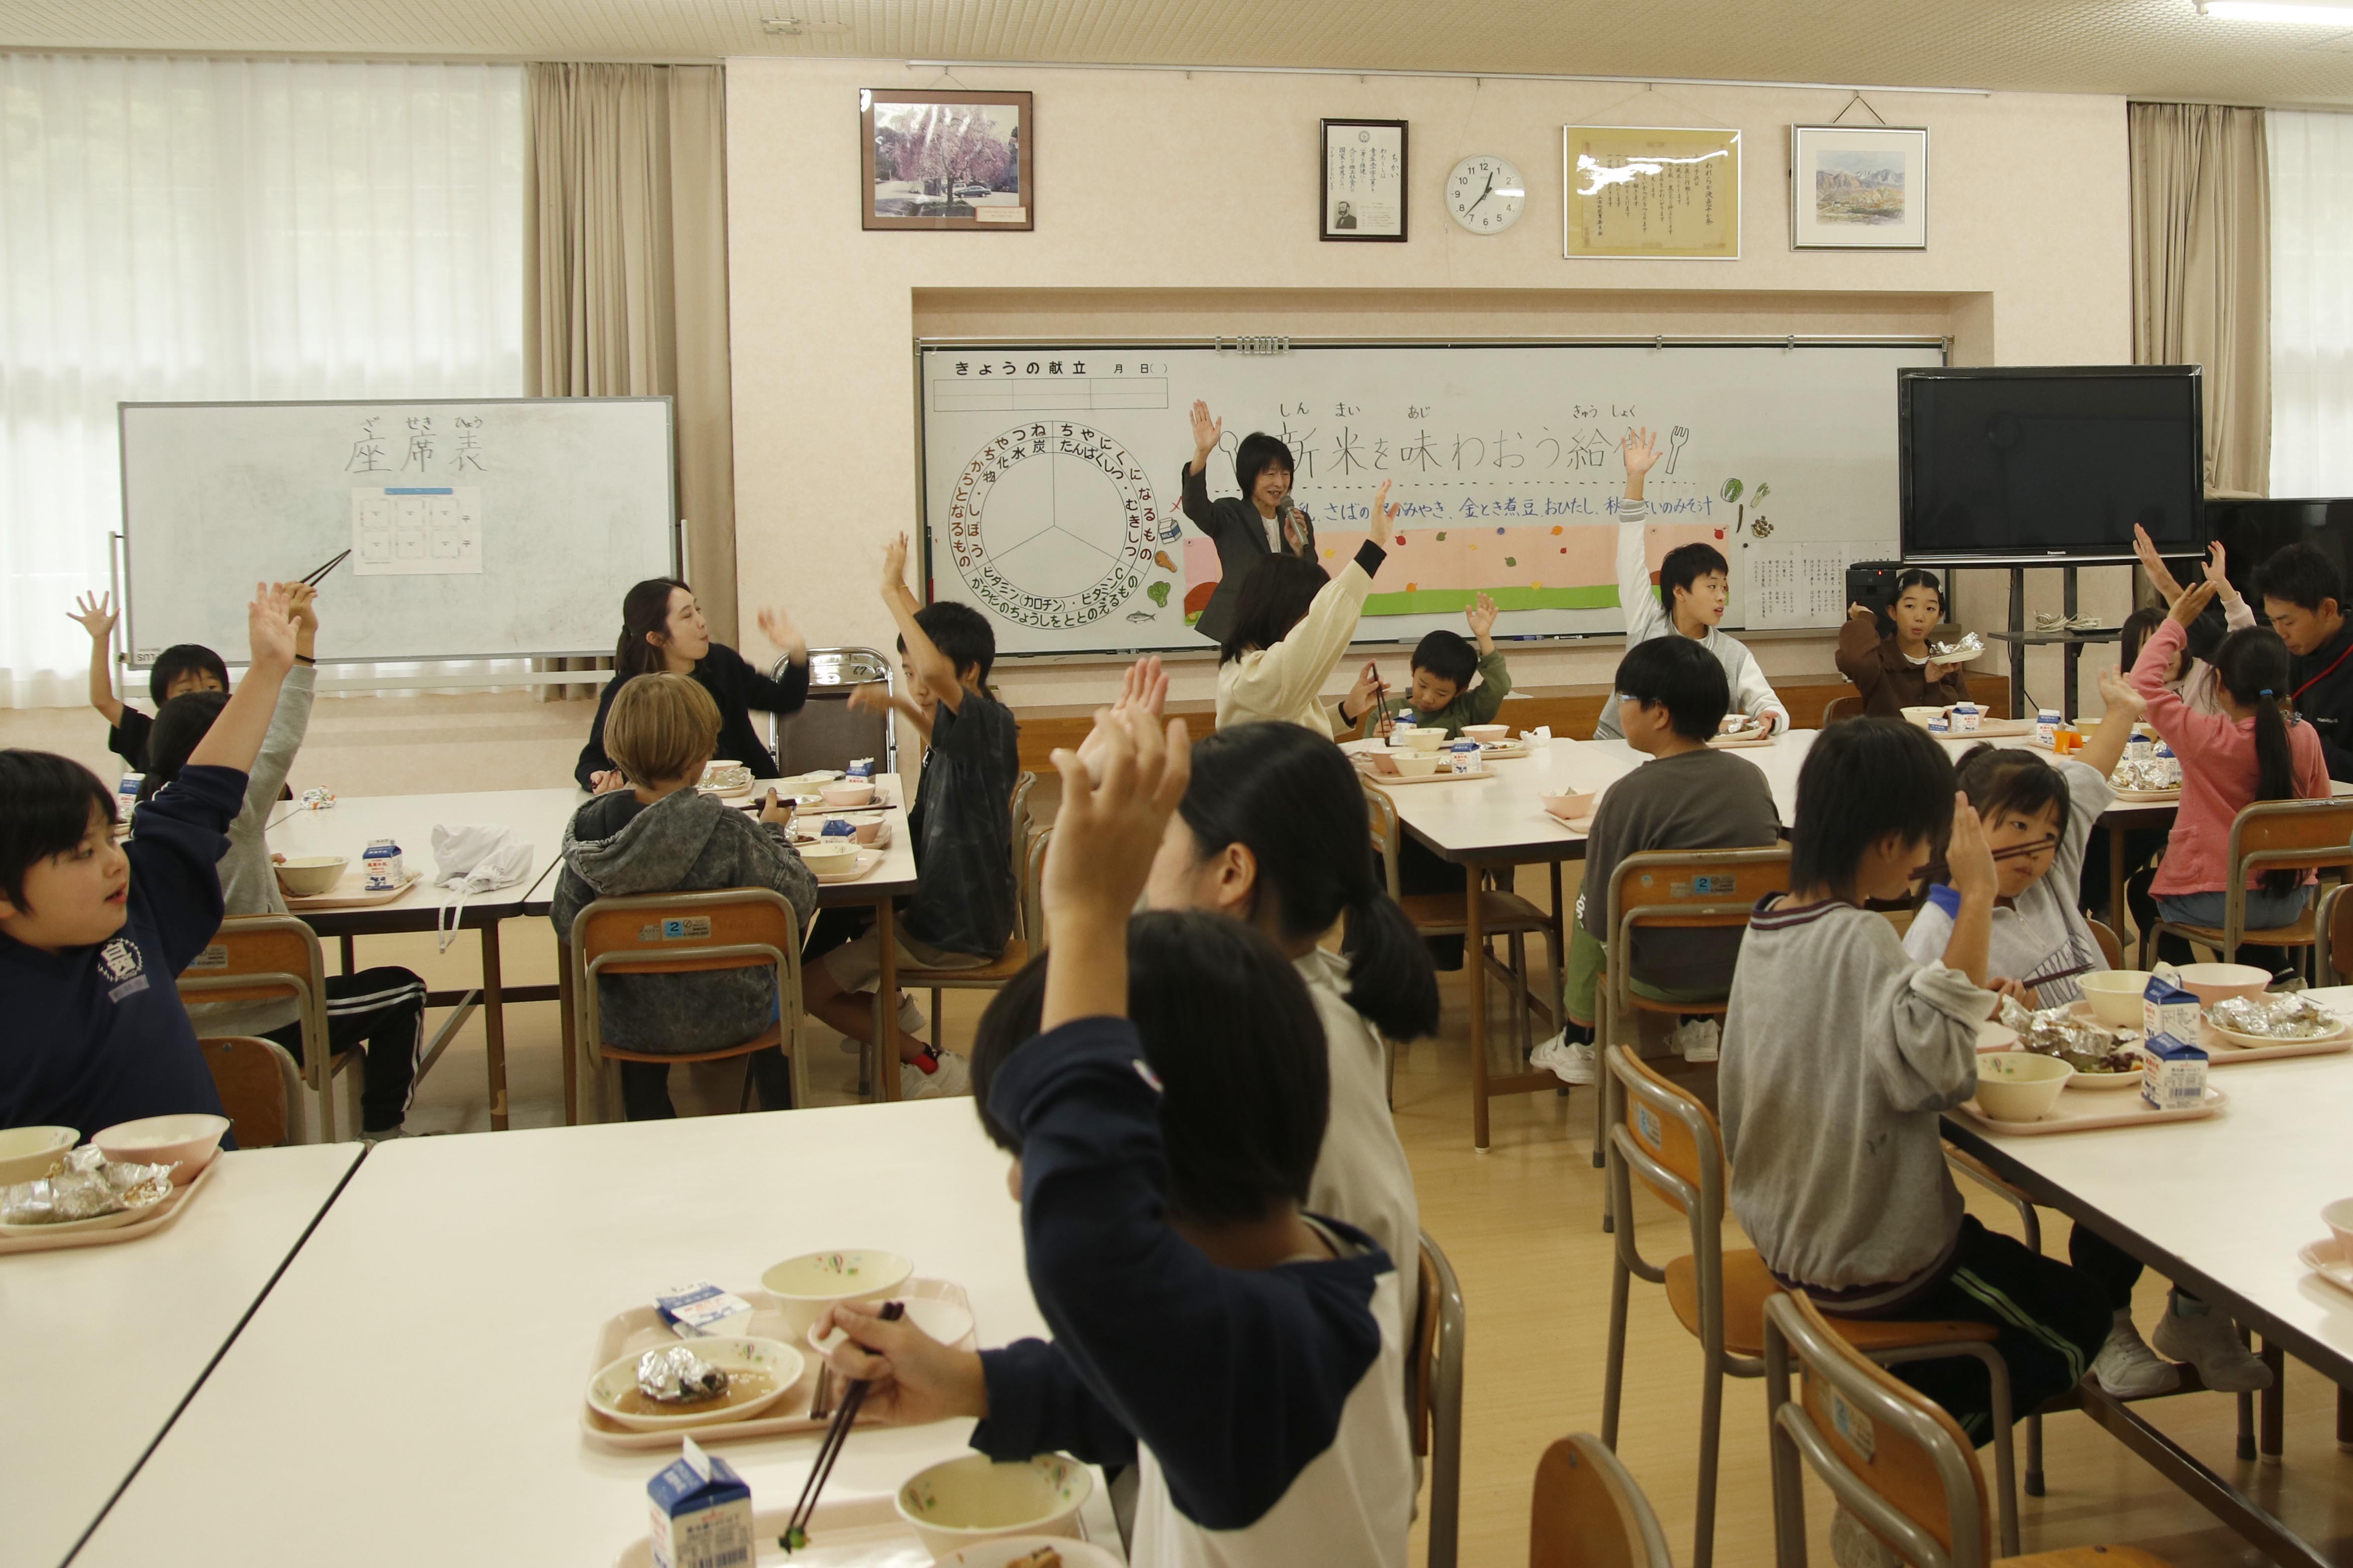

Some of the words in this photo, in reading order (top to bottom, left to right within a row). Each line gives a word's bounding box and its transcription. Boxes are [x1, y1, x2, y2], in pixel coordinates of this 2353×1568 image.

[1391, 153, 1399, 178] ちかい
[955, 360, 1087, 375] きょうの献立
[1280, 402, 1309, 416] しん
[1335, 402, 1361, 417] まい
[1408, 405, 1430, 419] あじ
[1573, 405, 1598, 418] きゅう
[1612, 405, 1636, 417] しょく
[406, 416, 432, 430] せき
[455, 415, 482, 428] ひょう
[344, 430, 488, 473] 座席表
[1699, 879, 1707, 887] 2
[670, 922, 678, 931] 2
